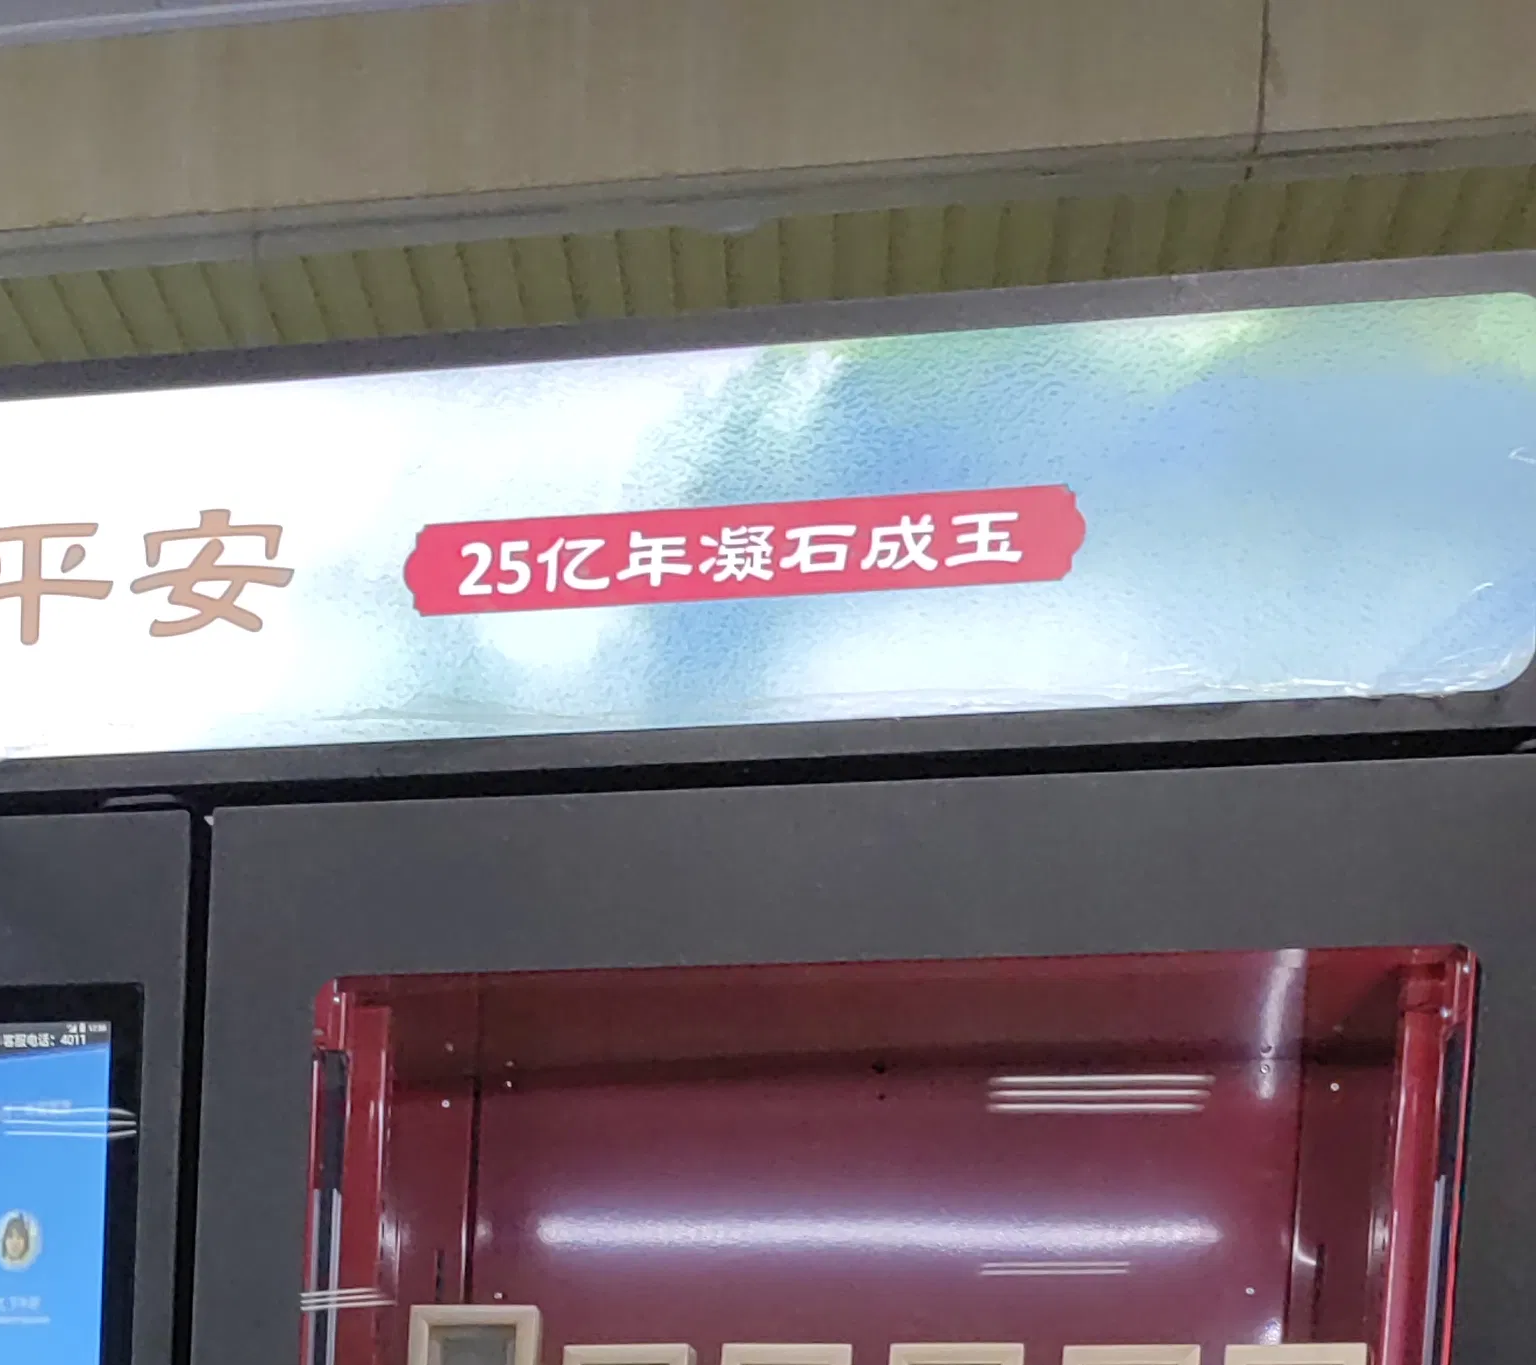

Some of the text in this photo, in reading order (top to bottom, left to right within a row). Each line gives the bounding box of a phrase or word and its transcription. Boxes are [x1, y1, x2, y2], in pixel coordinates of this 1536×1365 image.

[457, 510, 1024, 596] 25亿年凝石成玉
